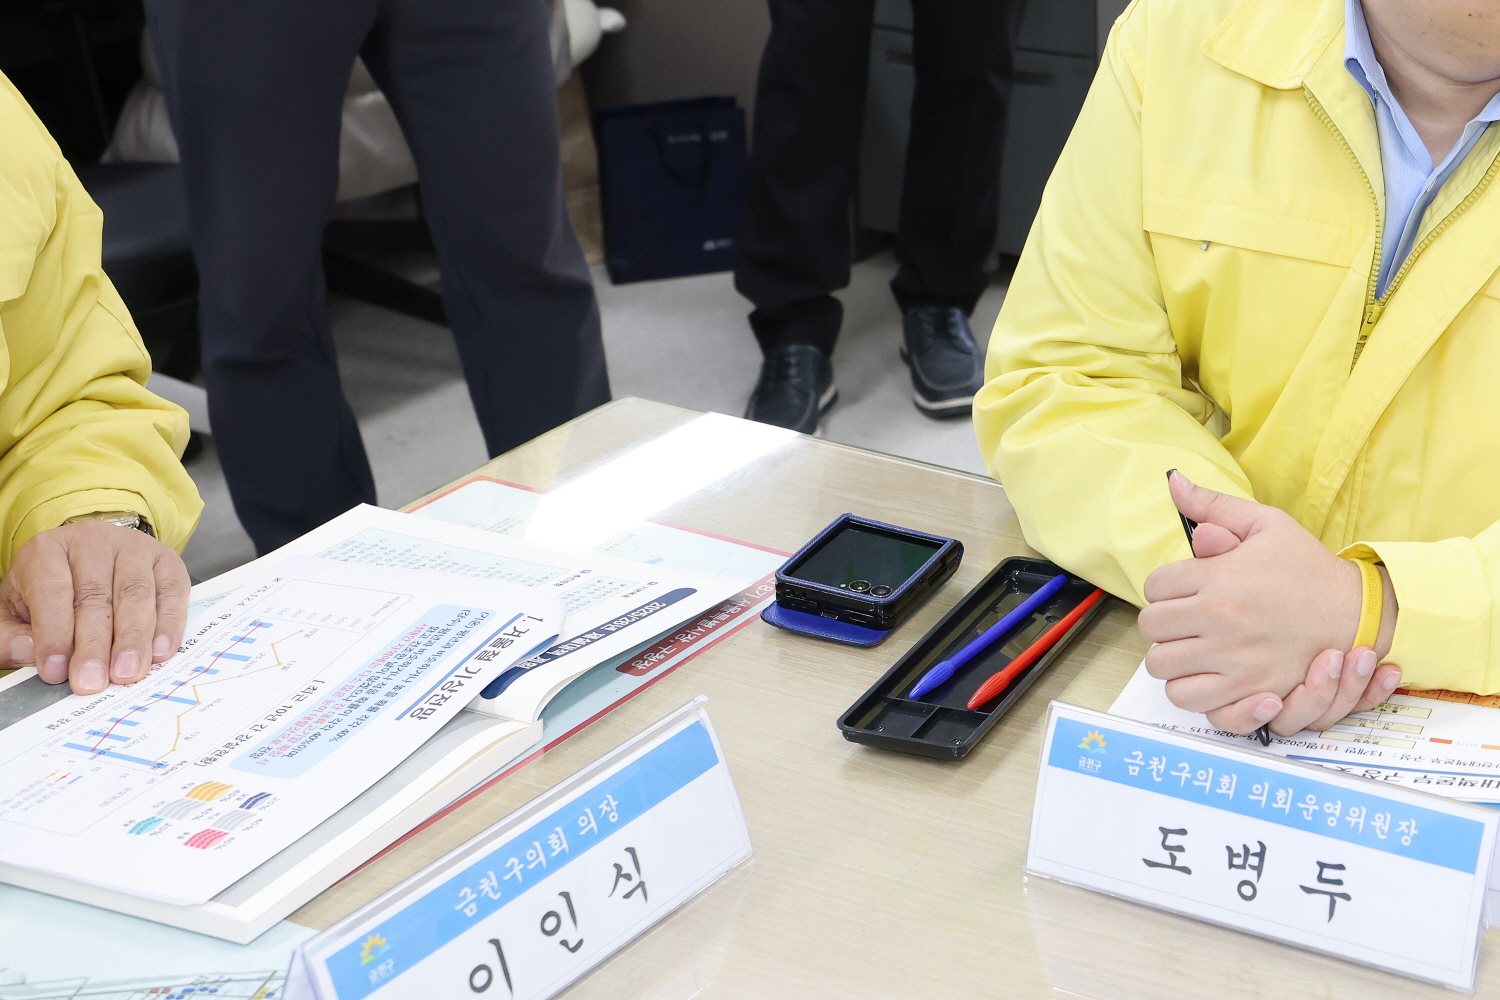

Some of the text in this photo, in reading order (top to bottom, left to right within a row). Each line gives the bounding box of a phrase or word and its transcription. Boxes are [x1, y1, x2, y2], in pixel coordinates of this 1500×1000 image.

[445, 609, 471, 626] (강수)
[464, 611, 491, 628] (기온)
[195, 621, 219, 635] 3cm
[400, 623, 429, 641] 서해안
[421, 627, 451, 646] 평년과
[440, 629, 470, 648] 평년과
[393, 640, 422, 659] 건조한
[631, 643, 678, 671] 구청장
[383, 647, 427, 680] 비슷하거나
[400, 650, 446, 683] 비슷하거나
[406, 615, 545, 720] 1. 겨울철 기상전망
[350, 670, 372, 683] 다소
[289, 685, 320, 701] 최근
[69, 693, 114, 716] 1cm미만
[262, 704, 294, 721] 10년
[313, 699, 335, 712] 눈이
[337, 696, 369, 716] 확률이
[43, 717, 72, 730] 강설
[248, 723, 267, 732] 간
[318, 717, 343, 731] 각각
[347, 714, 370, 728] 각각
[328, 728, 351, 742] 40%
[247, 745, 272, 759] 전망
[1342, 746, 1385, 756] 13개반
[1398, 753, 1427, 761] 구성
[1078, 756, 1102, 771] 금천구
[1123, 749, 1419, 847] 금천구의회 의회운영위원장
[455, 795, 621, 918] 금천구의회 의장
